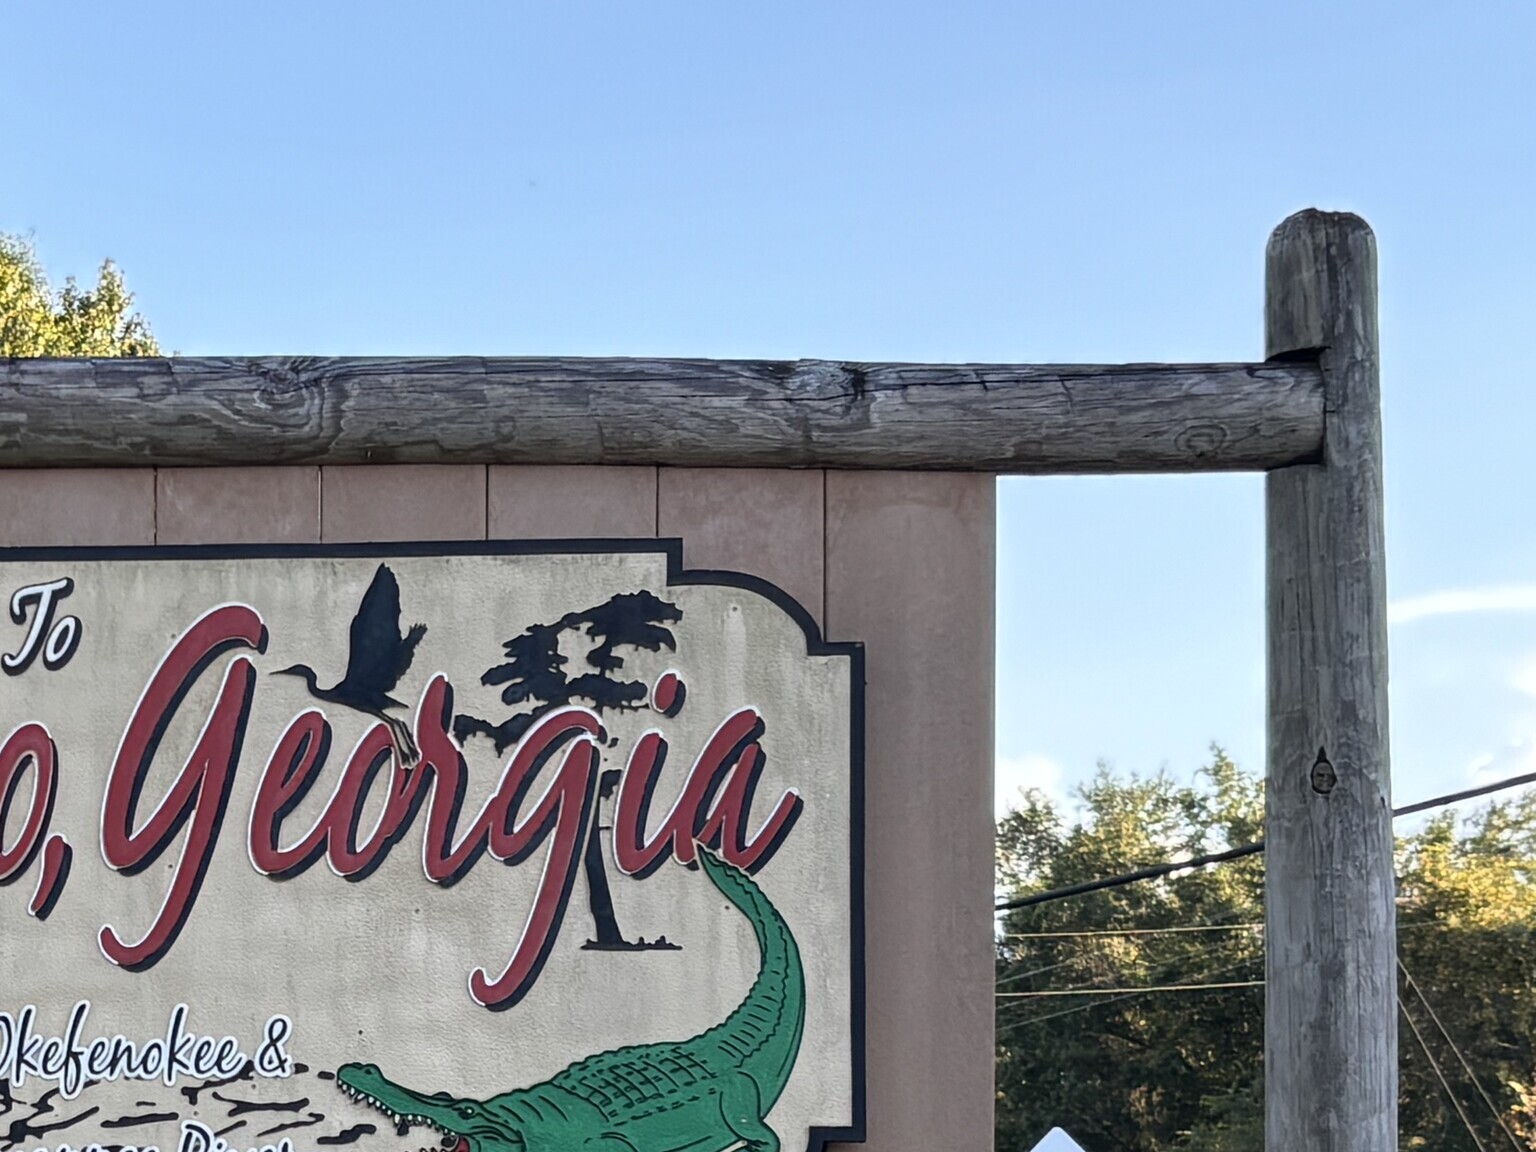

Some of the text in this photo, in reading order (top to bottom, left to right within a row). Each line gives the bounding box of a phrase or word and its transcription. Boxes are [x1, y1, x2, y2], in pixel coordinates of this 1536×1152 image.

[1, 577, 81, 675] To
[99, 603, 803, 1011] Georgia
[255, 1014, 292, 1078] &
